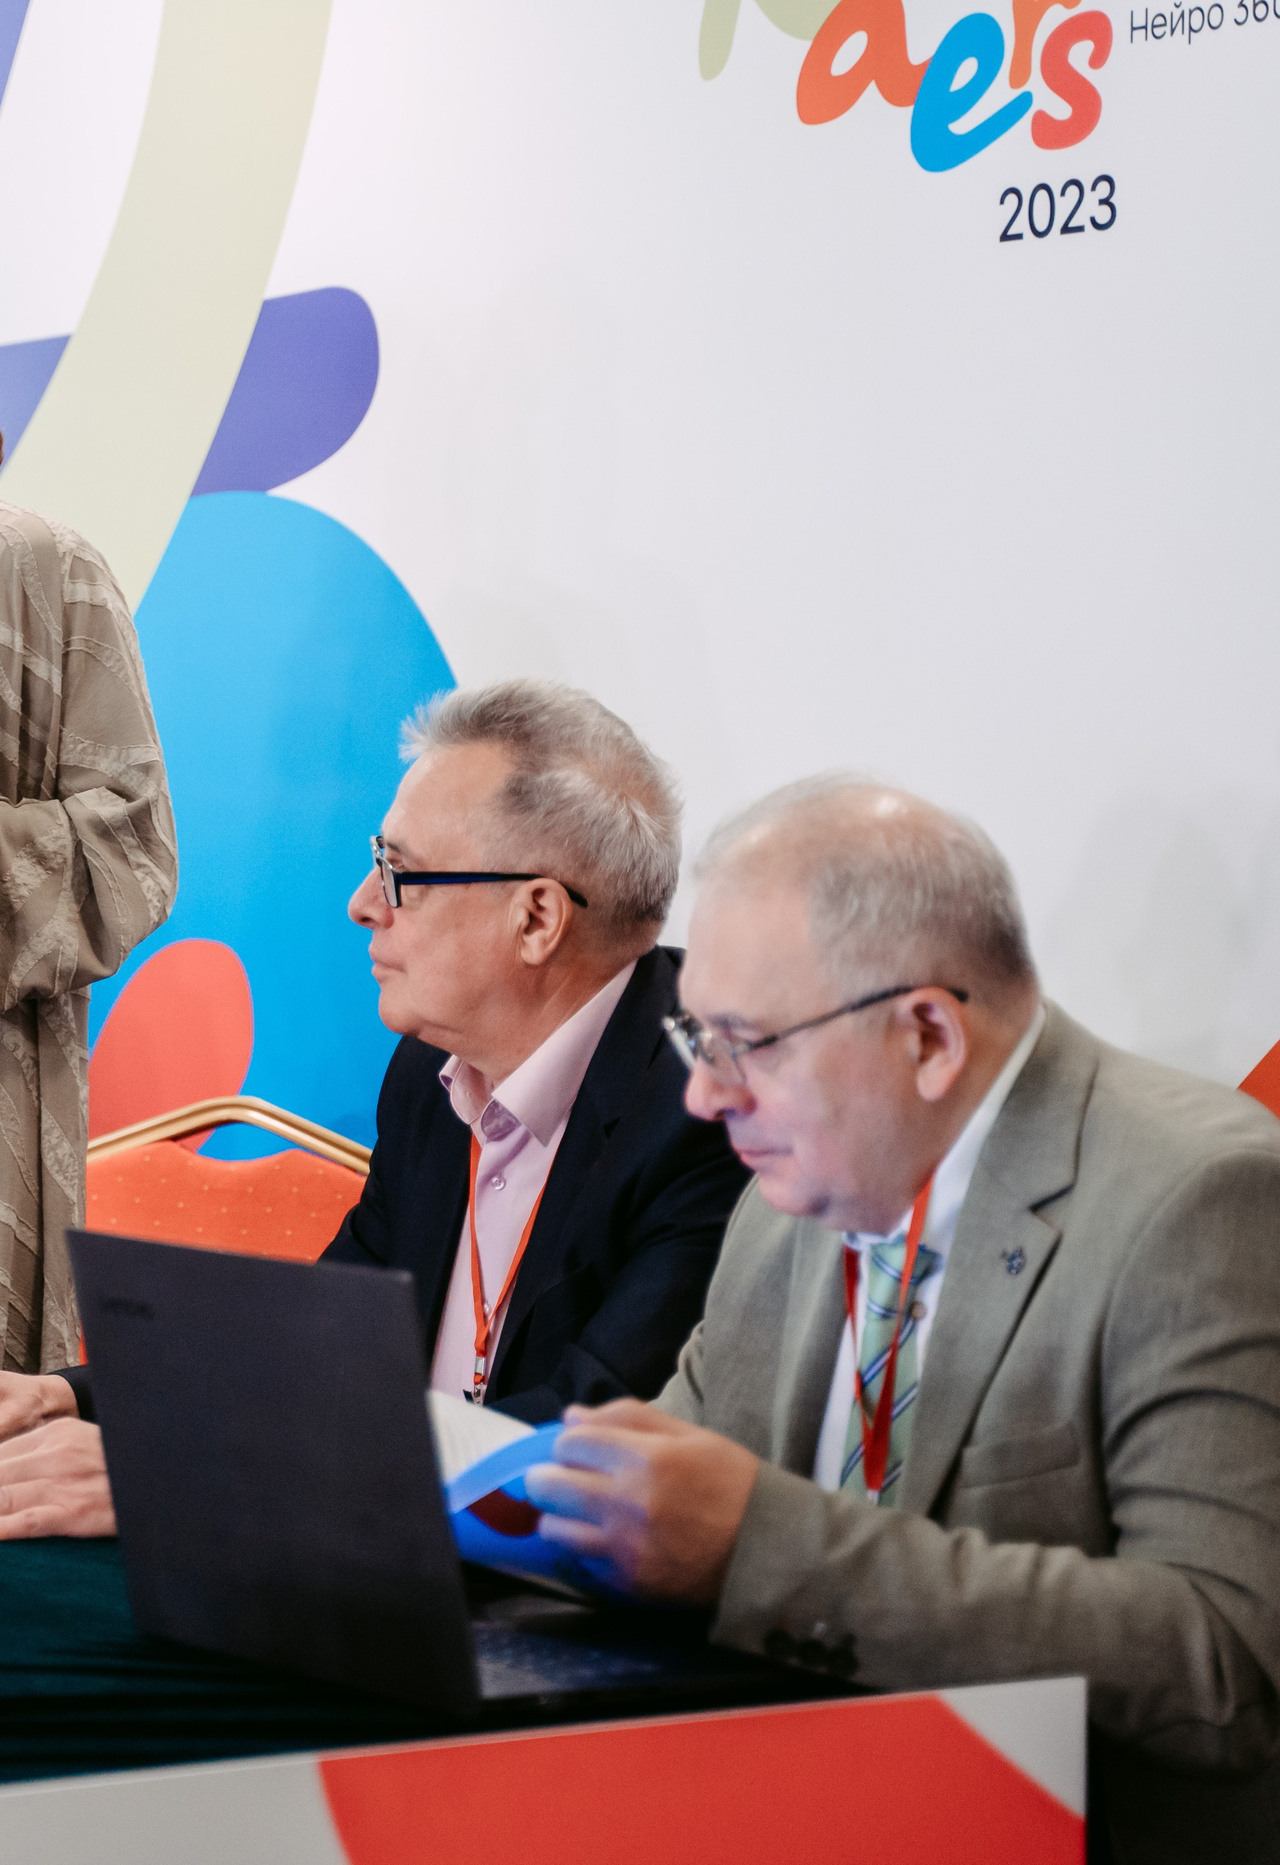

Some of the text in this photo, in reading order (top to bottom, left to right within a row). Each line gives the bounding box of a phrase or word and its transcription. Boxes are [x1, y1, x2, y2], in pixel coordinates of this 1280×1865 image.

[1130, 0, 1280, 45] Нейро 36
[999, 174, 1117, 243] 2023
